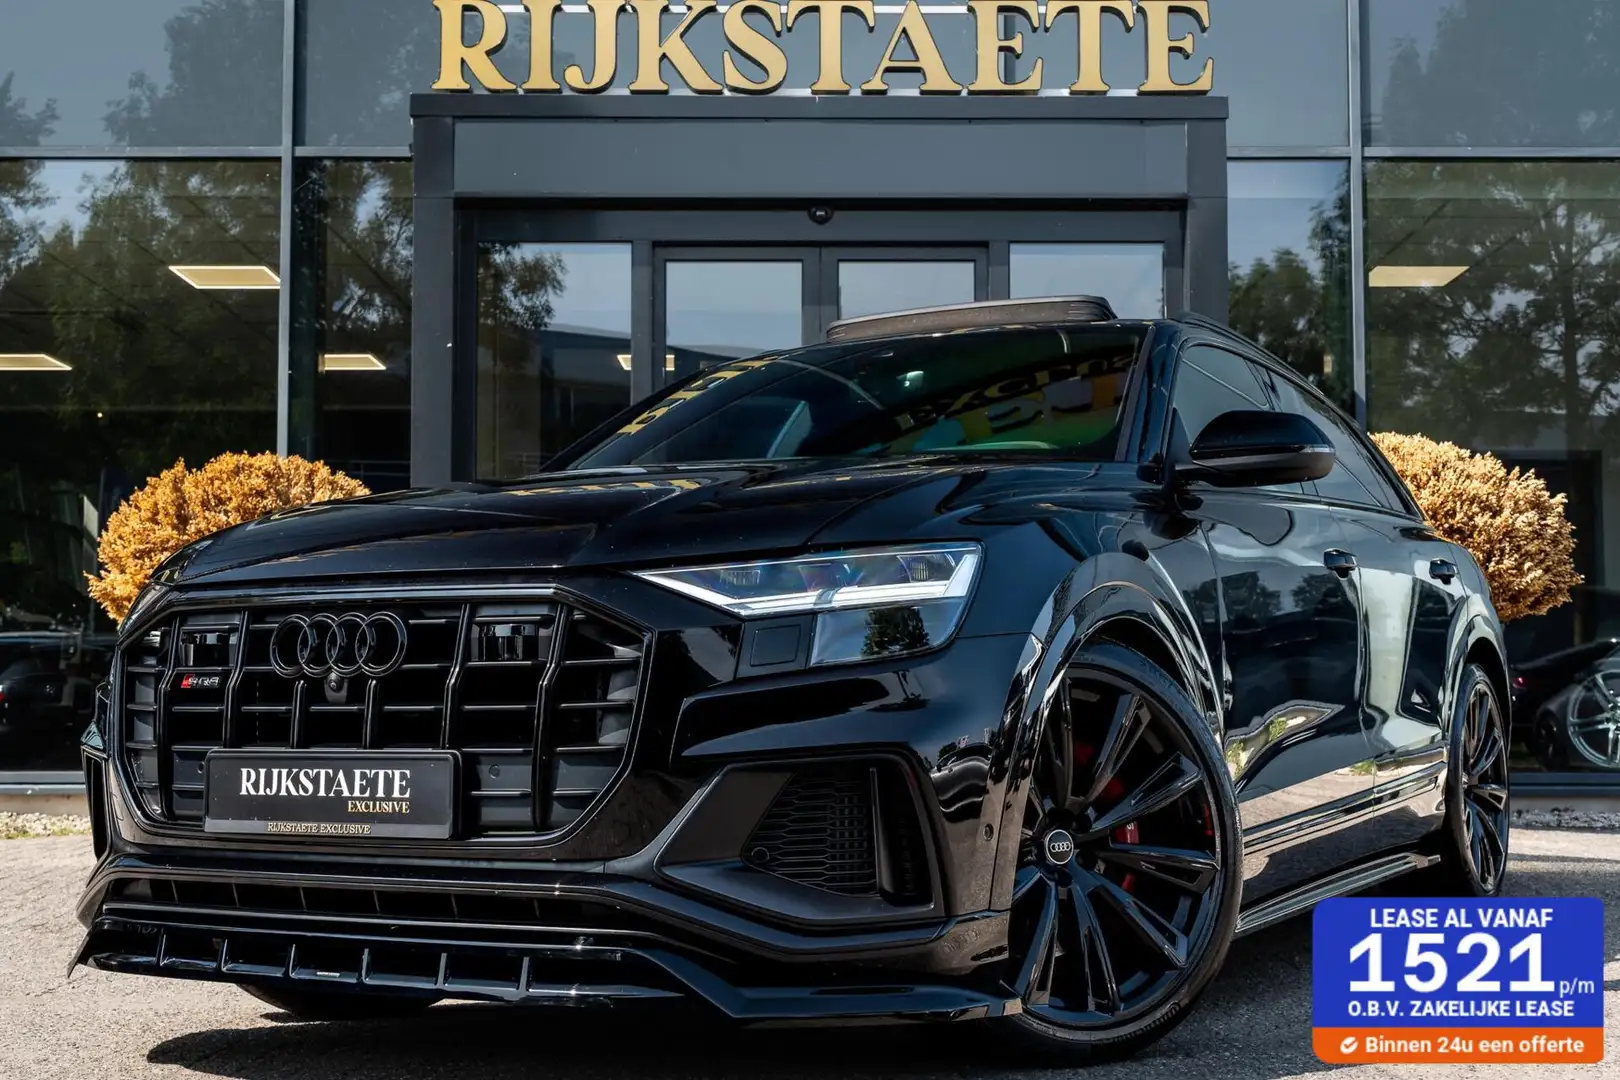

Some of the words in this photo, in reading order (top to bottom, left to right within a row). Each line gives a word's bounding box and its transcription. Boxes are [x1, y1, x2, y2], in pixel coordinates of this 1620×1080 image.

[431, 0, 1214, 94] RIJKSTAETE
[239, 767, 411, 799] RIJKSTAETE
[347, 800, 410, 814] EXCLUSIVE
[267, 822, 318, 834] RIJKSTAETE
[320, 824, 371, 835] EXCLUSIVE
